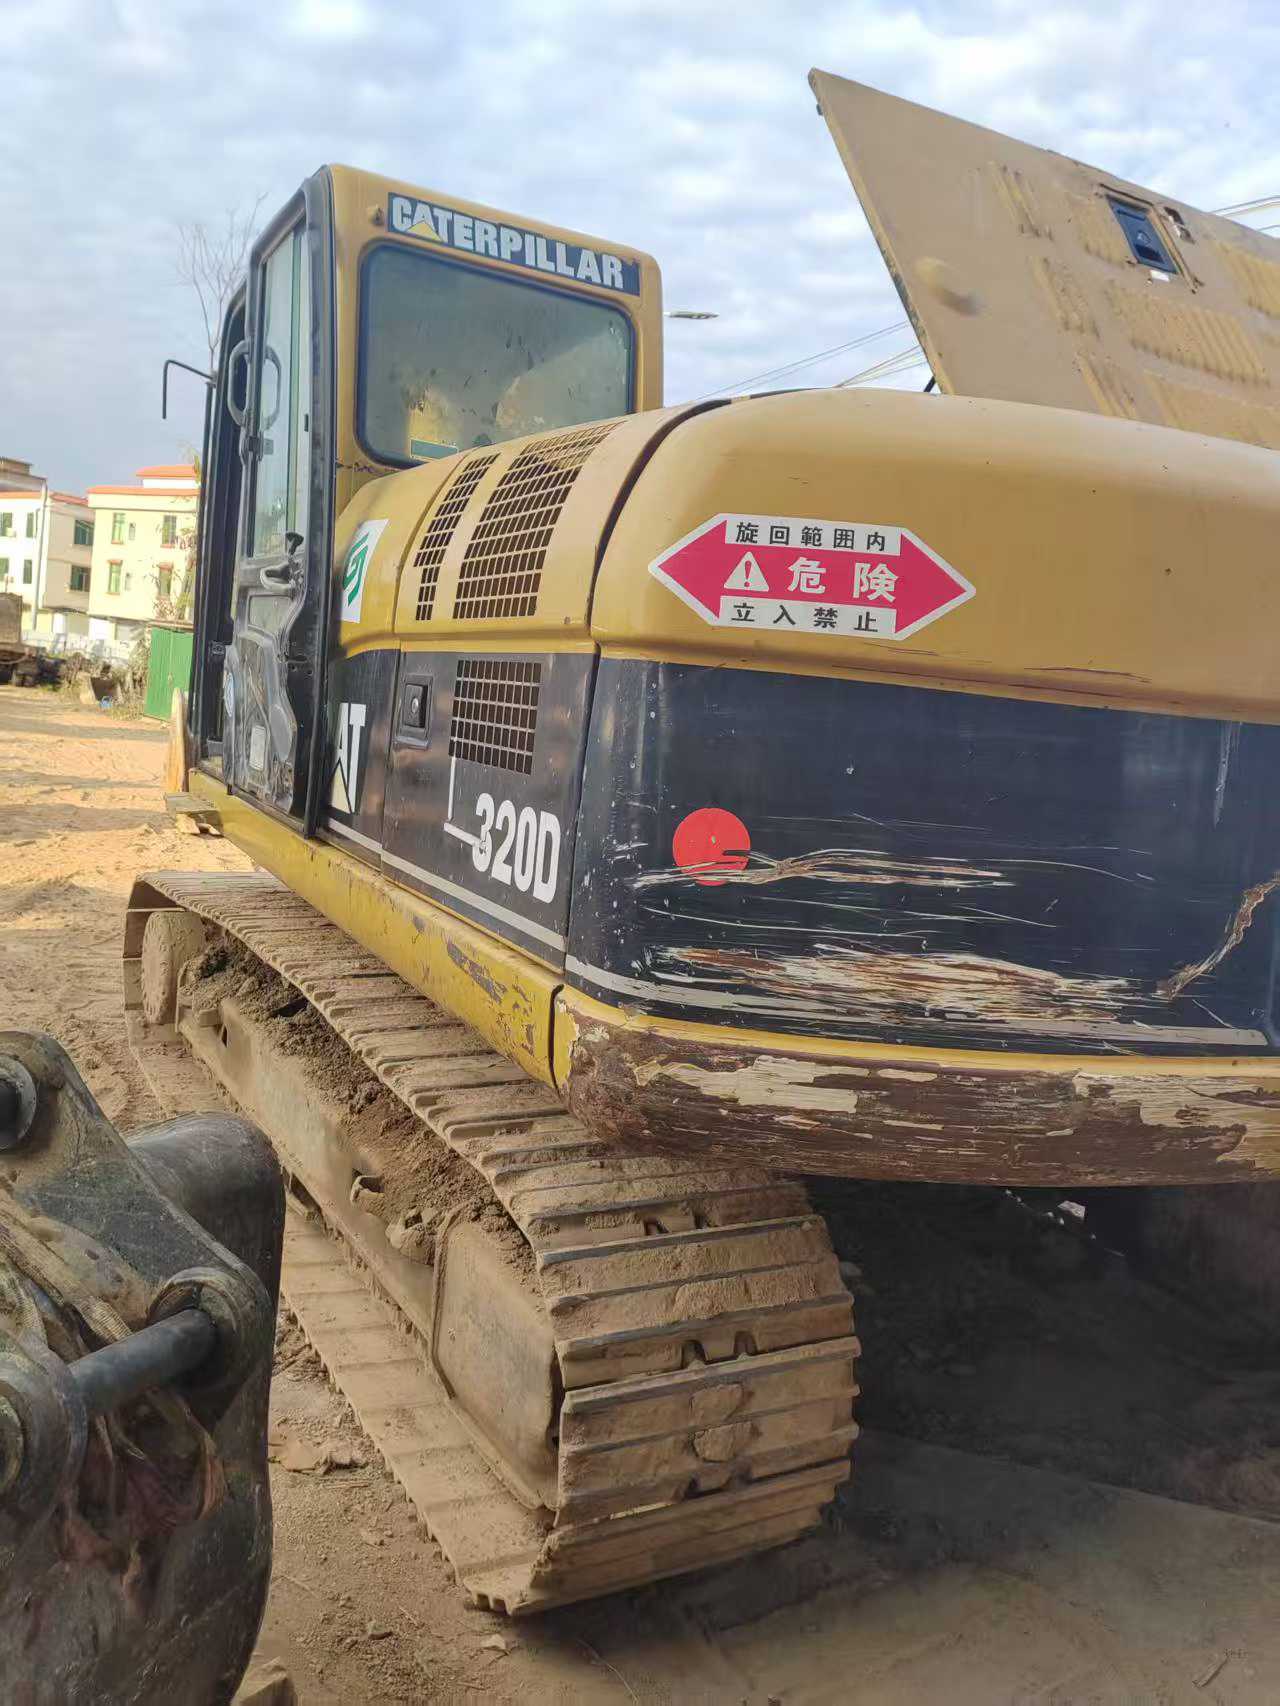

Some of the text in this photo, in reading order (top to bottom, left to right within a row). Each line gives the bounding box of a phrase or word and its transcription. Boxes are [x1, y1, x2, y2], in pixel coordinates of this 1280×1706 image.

[391, 196, 624, 289] CATERPILLAR
[735, 521, 887, 552] 旋回範囲内
[787, 556, 899, 603] 危険
[731, 602, 879, 633] 立入禁止
[331, 702, 367, 815] AT
[472, 792, 562, 904] 320D
